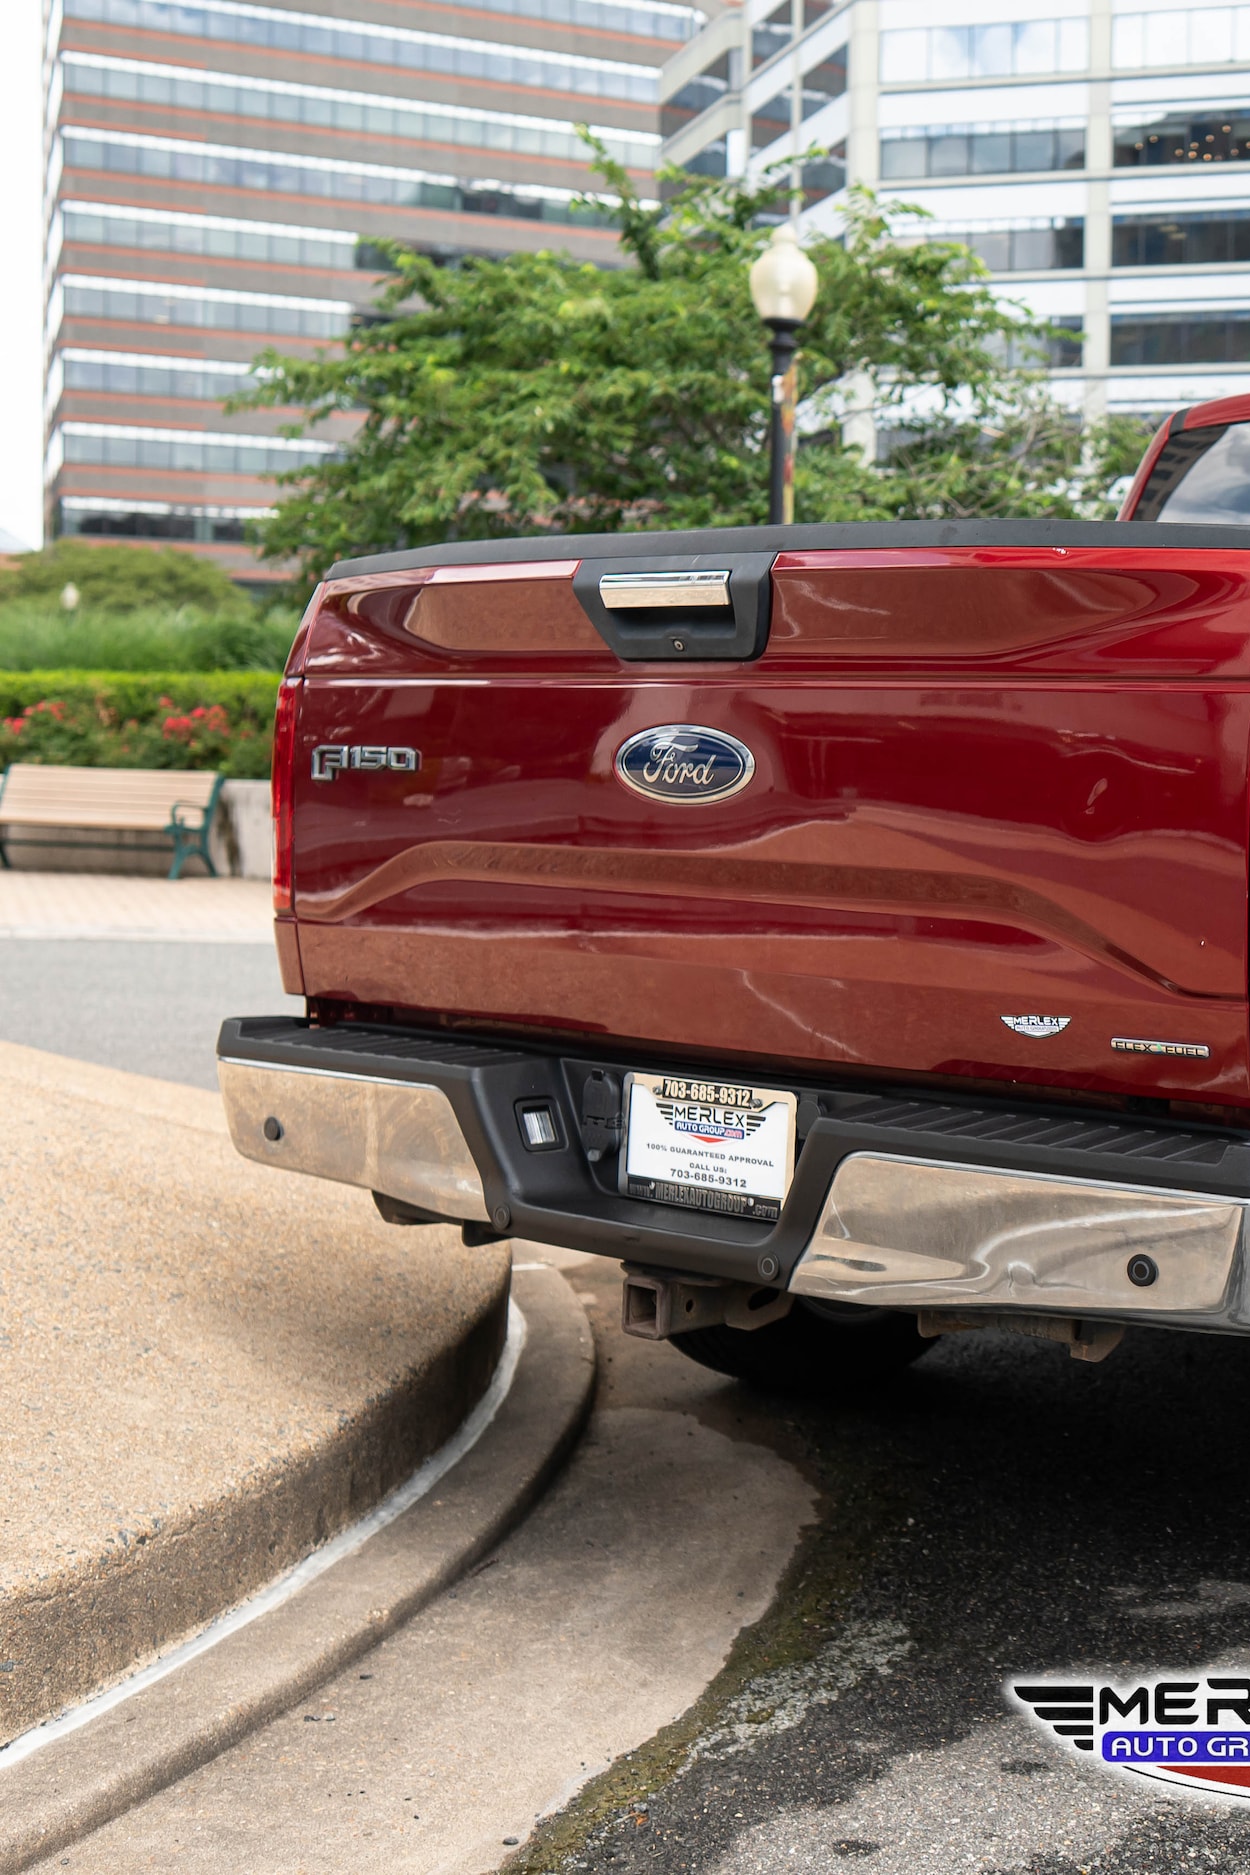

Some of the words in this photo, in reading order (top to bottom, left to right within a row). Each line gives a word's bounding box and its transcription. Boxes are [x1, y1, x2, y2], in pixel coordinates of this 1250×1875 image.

[642, 740, 716, 786] Ford
[1013, 1015, 1059, 1026] MERLEX
[1113, 1041, 1153, 1053] FLEX
[1165, 1045, 1206, 1057] FUEL
[664, 1079, 752, 1107] 703-685-9312
[674, 1106, 745, 1128] MERLEX
[676, 1121, 698, 1132] AUTO
[646, 1143, 668, 1152] 100%
[669, 1146, 726, 1160] GUARANTEED
[728, 1155, 775, 1168] APPROVAL
[689, 1162, 711, 1171] CALL
[670, 1168, 748, 1188] 703-685-9312
